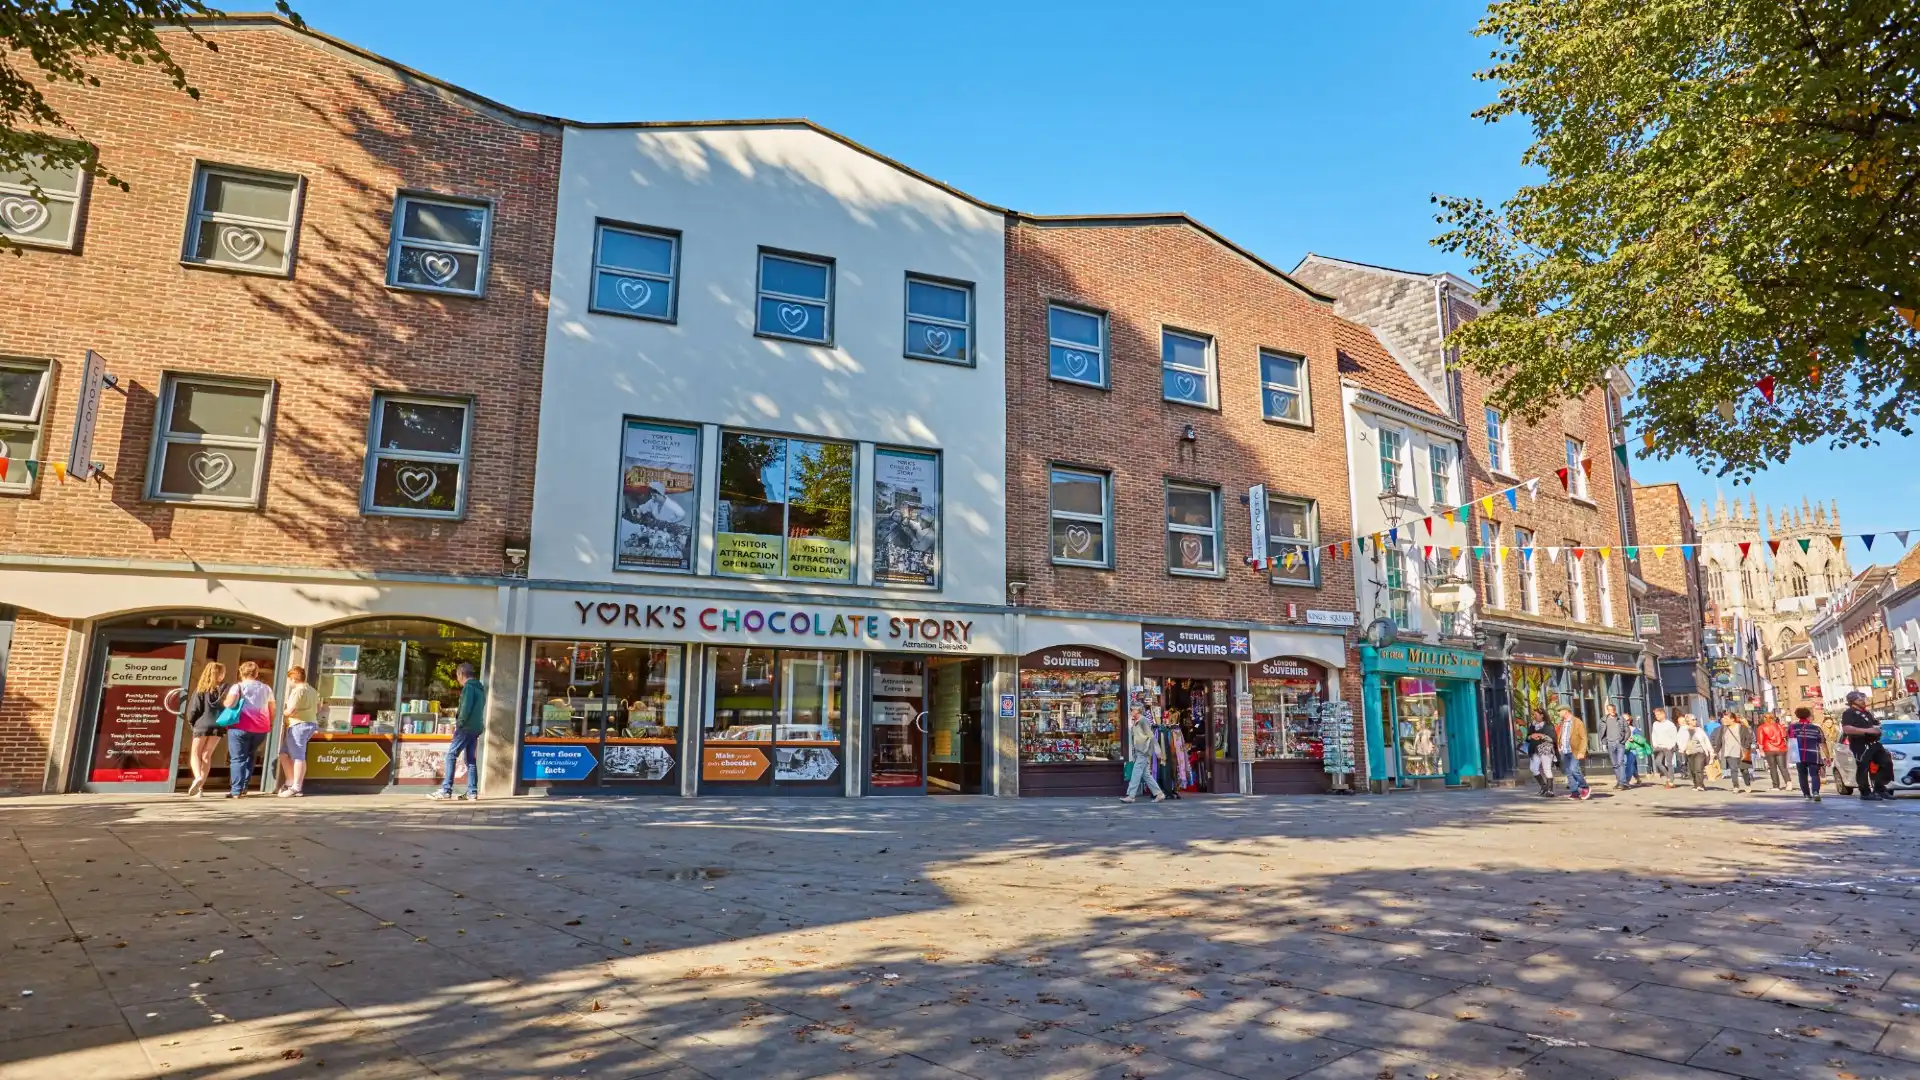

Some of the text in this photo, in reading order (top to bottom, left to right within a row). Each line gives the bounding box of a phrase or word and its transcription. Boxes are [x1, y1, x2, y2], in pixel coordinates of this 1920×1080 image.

[732, 540, 767, 549] VISITOR
[720, 549, 779, 560] ATTRACTION
[802, 545, 835, 555] VISITOR
[790, 554, 847, 565] ATTRACTION
[722, 560, 776, 570] OPEN DAILY
[792, 565, 844, 574] OPEN DAILY
[699, 607, 878, 638] CHOCOLATE
[889, 617, 973, 641] STORY
[1179, 632, 1216, 641] STERLING
[902, 640, 937, 649] Attraction
[1408, 647, 1458, 666] MILLIE'S
[125, 663, 148, 671] Shop
[328, 746, 346, 755] Join
[316, 755, 372, 764] fully guided
[720, 759, 757, 767] chocolate
[544, 766, 566, 774] facts
